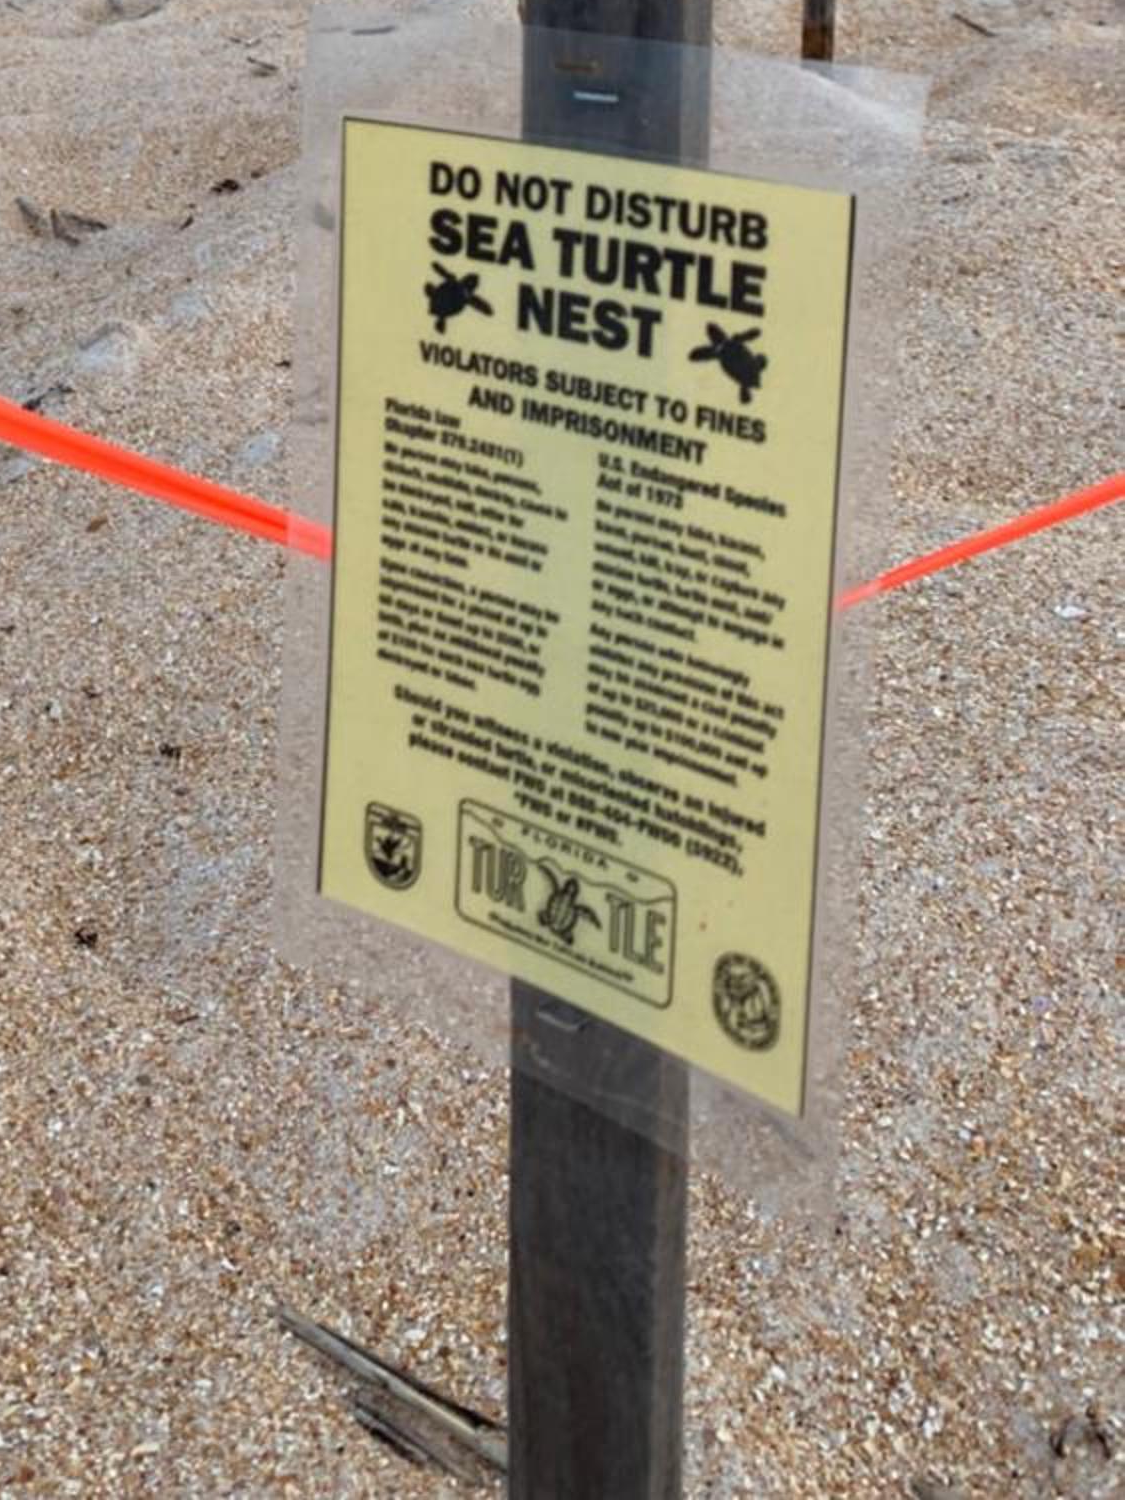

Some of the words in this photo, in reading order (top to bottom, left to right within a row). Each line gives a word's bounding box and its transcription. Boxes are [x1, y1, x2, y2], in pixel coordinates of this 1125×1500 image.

[429, 161, 482, 201] DO
[495, 171, 572, 215] NOT
[586, 186, 767, 250] DISTURB
[430, 209, 534, 270] SEA
[554, 229, 765, 315] TURTLE
[518, 284, 661, 357] NEST
[420, 341, 538, 387] VIOLATORS
[545, 370, 648, 413] SUBJECT
[654, 395, 688, 424] TO
[695, 405, 766, 444] FINES
[468, 386, 515, 416] AND
[522, 399, 705, 463] IMPRISONMENT
[521, 823, 608, 869] FLORIDA
